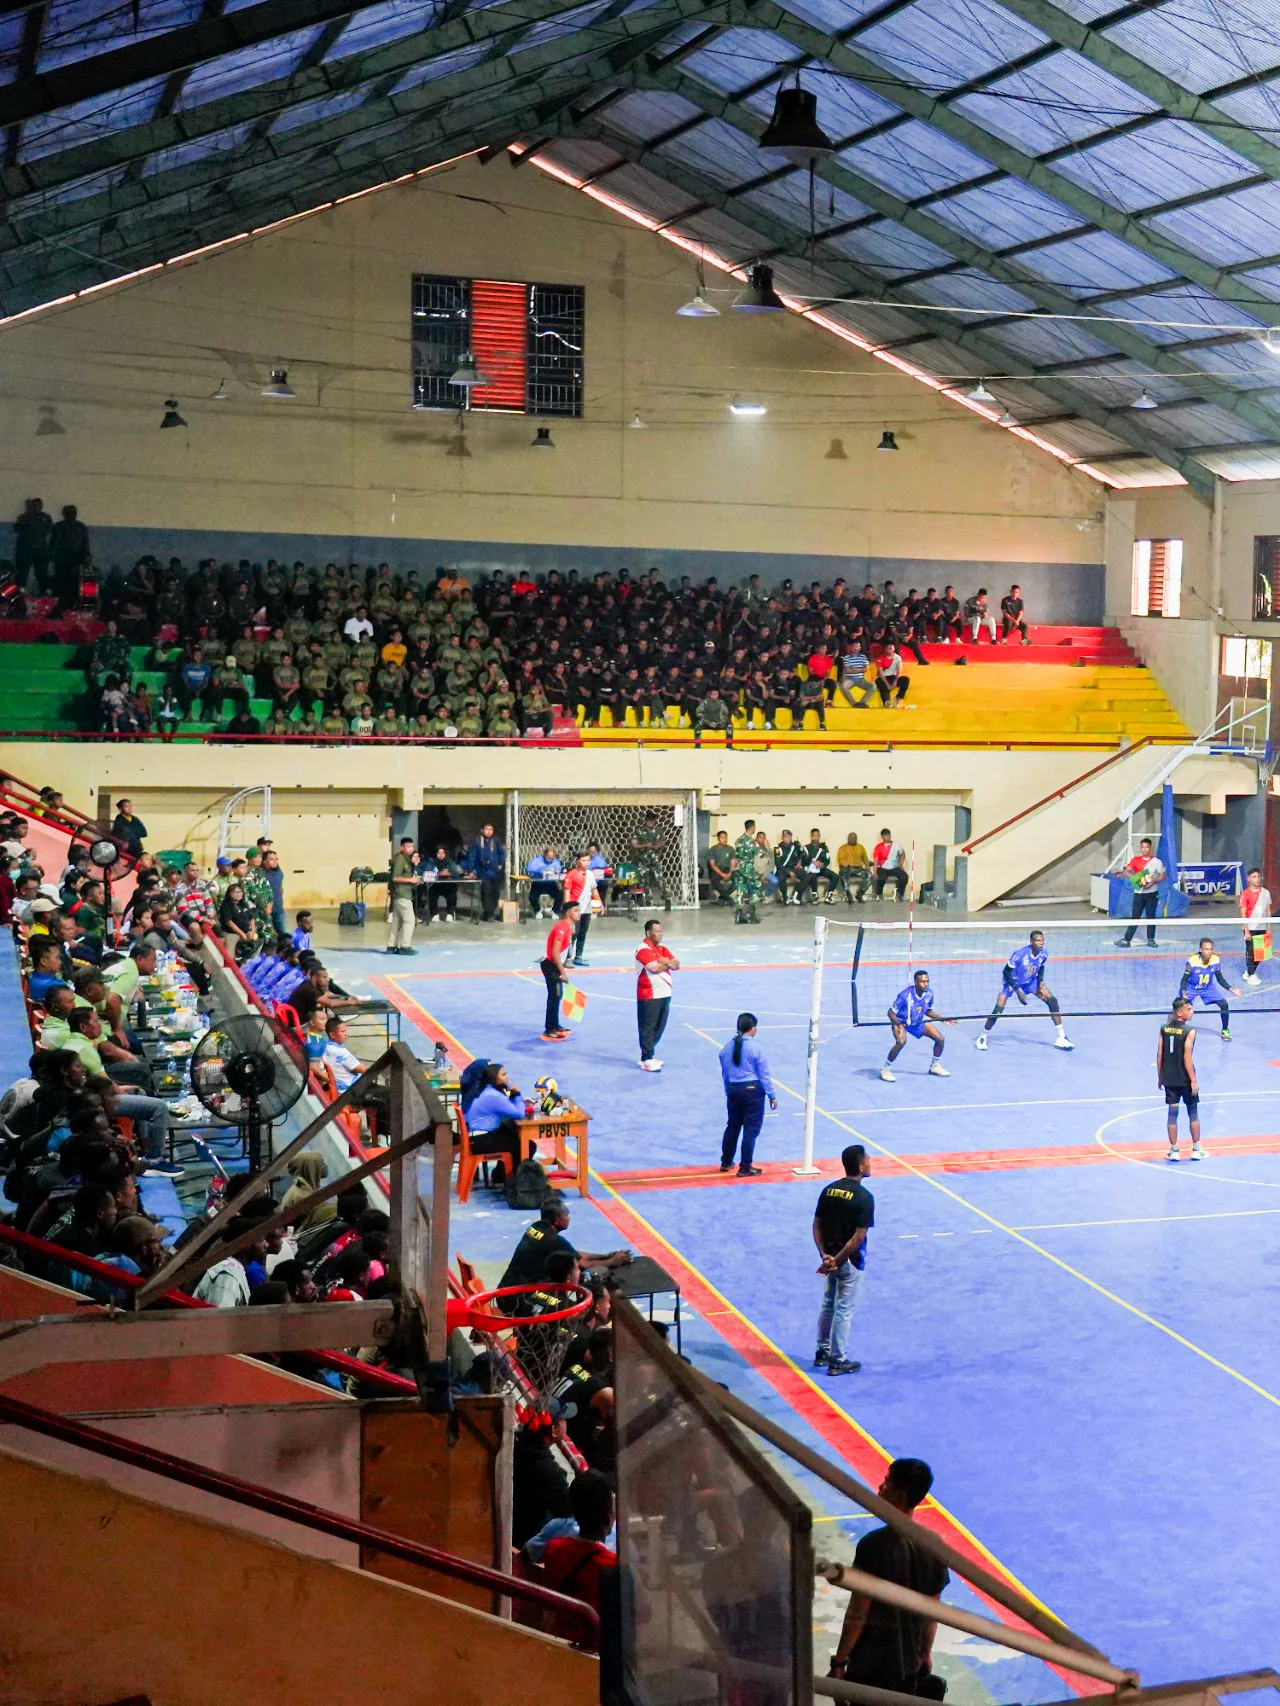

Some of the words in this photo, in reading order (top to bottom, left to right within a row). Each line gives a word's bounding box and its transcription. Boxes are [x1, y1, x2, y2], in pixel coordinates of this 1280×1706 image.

[1199, 974, 1210, 985] 14
[1169, 1036, 1175, 1053] 1
[538, 1122, 571, 1139] PBVSI
